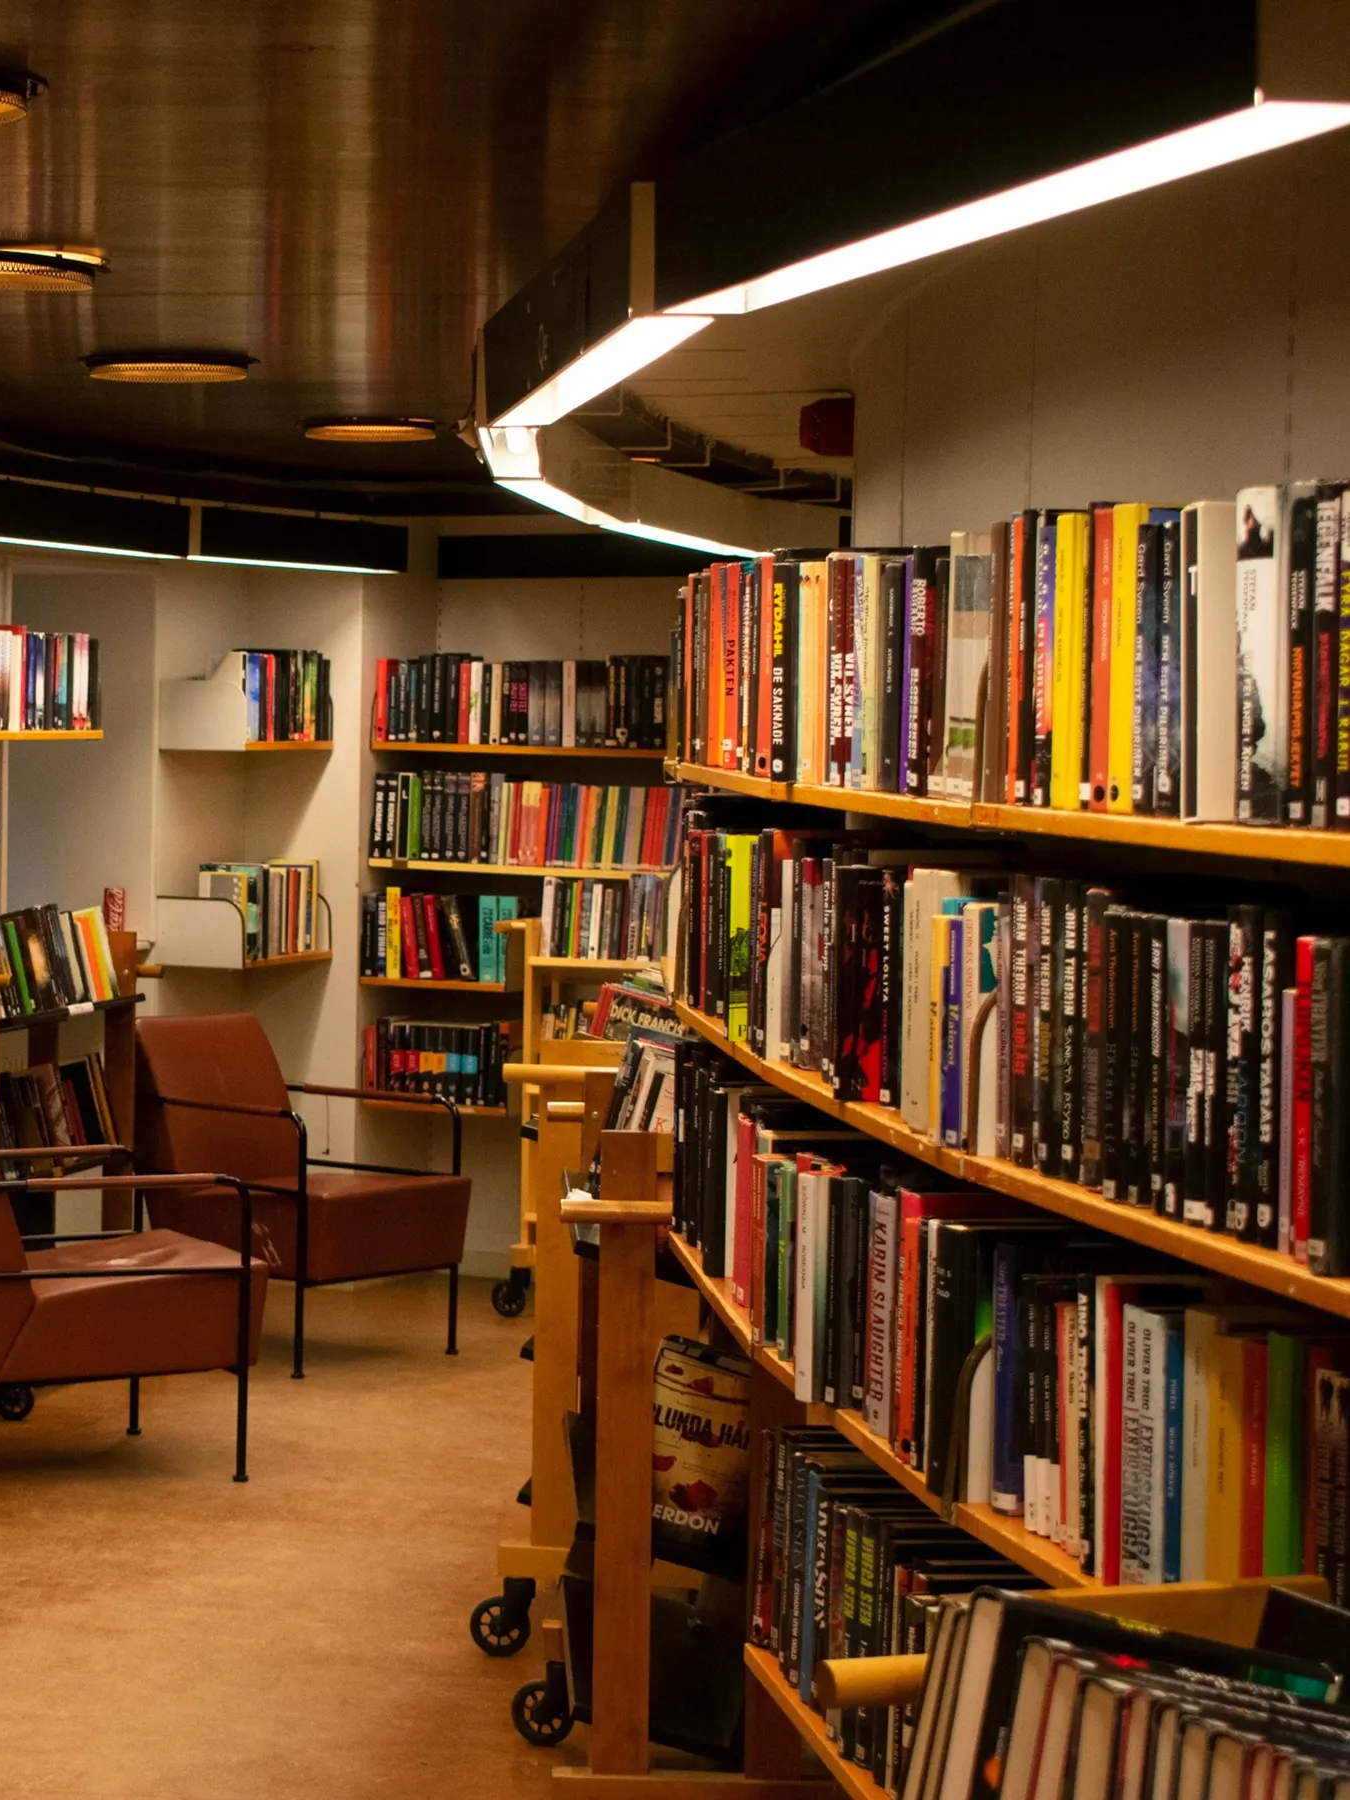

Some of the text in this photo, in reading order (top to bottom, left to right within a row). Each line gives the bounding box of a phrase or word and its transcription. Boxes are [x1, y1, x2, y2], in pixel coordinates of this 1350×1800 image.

[1315, 500, 1336, 612] TEGENFALK
[917, 578, 927, 636] ROBERTO
[1290, 570, 1299, 630] TEGENFALK
[1298, 570, 1307, 609] STEFAN
[726, 639, 736, 697] PAKTEN
[772, 582, 783, 746] RYDAHL DE SAKNADE
[1135, 634, 1143, 661] DEN
[1158, 540, 1172, 777] Gard Sveen DEN SISTE PILGRIMEN
[1134, 664, 1143, 701] SISTE
[1132, 705, 1143, 777] PILGRIMEN
[1290, 646, 1304, 788] NIRVANAPROJEKTET
[824, 880, 833, 924] Emelie
[1014, 896, 1027, 942] JOHAN
[1040, 900, 1052, 946] JOHAN
[758, 901, 768, 964] LEONA
[822, 926, 833, 971] Schepp
[882, 956, 890, 1003] LOLITA
[965, 918, 974, 1010] GEORGES SIMENON
[1014, 948, 1026, 1005] THEORIN
[1040, 953, 1052, 1011] THEORIN
[1240, 956, 1255, 1033] HENRIK
[1260, 930, 1277, 1056] LASAROS
[610, 1004, 684, 1036] DICK FRANCIS
[1062, 903, 1078, 1140] JOHAN THEORIN SANKTA PSYKO
[1296, 1152, 1306, 1218] TREMAYNE
[870, 1221, 887, 1402] KARIN SLAUGHTER
[1078, 1292, 1089, 1420] AINO TROSELL
[1126, 1320, 1136, 1367] OLIVIER
[1142, 1327, 1152, 1374] OLIVIER
[1126, 1370, 1135, 1402] TRUC
[1141, 1378, 1150, 1410] TRUC
[652, 1402, 712, 1434] LUNDA
[652, 1502, 721, 1536] ERDON
[844, 1528, 858, 1581] VIVECA
[860, 1536, 875, 1588] VIVECA
[843, 1584, 856, 1619] STEN
[858, 1590, 874, 1627] STEN
